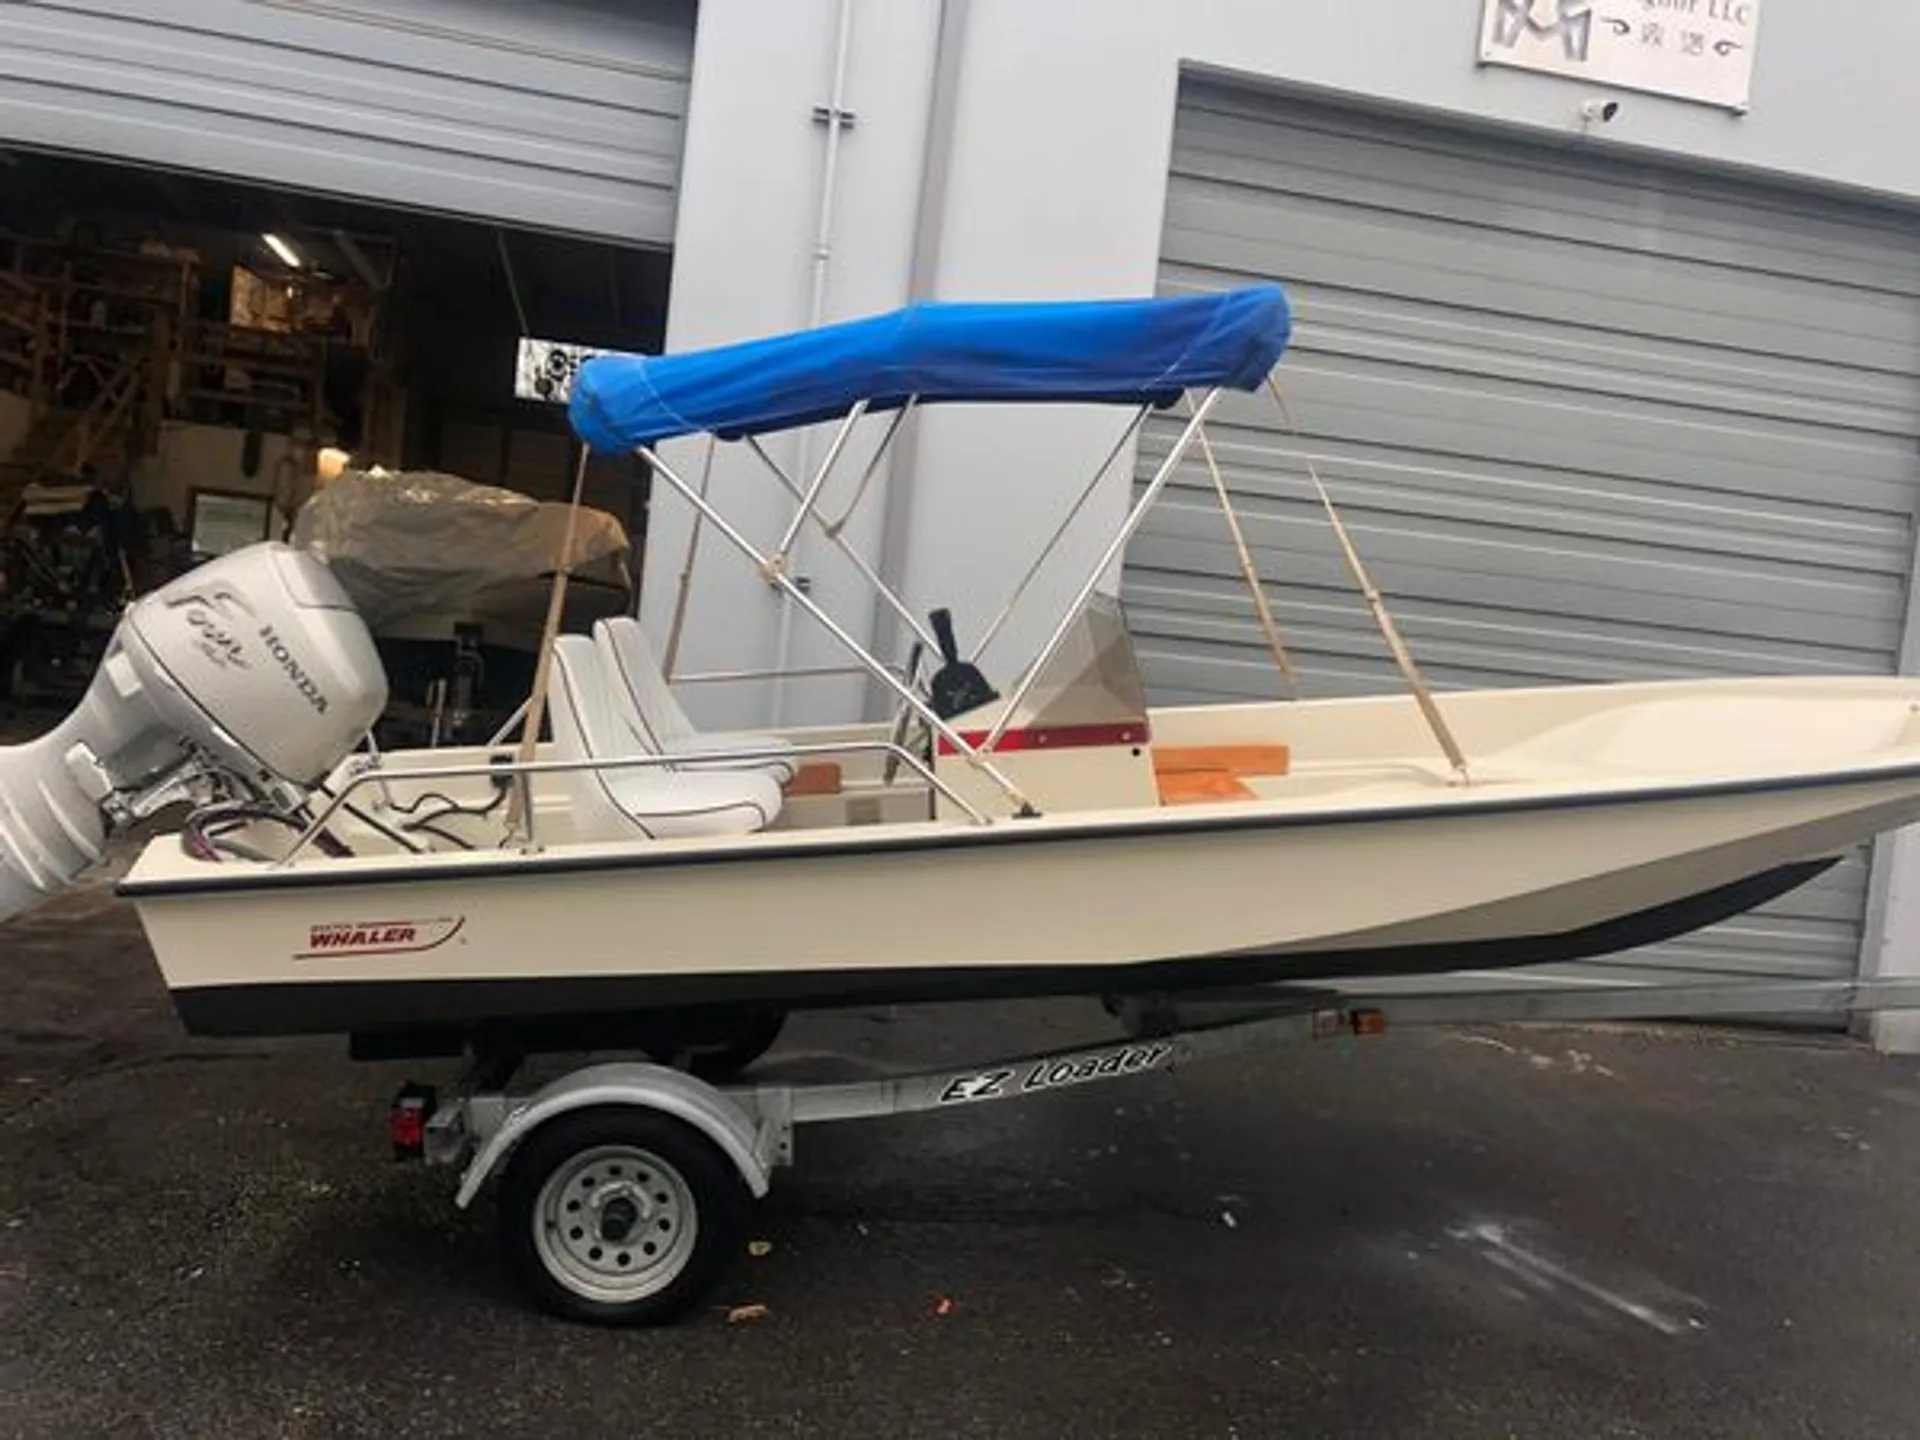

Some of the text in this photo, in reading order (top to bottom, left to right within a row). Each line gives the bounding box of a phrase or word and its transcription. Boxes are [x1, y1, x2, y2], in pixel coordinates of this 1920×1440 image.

[258, 622, 330, 716] HONDA
[310, 928, 416, 948] WHALER
[939, 1042, 1173, 1105] EZ Loader
